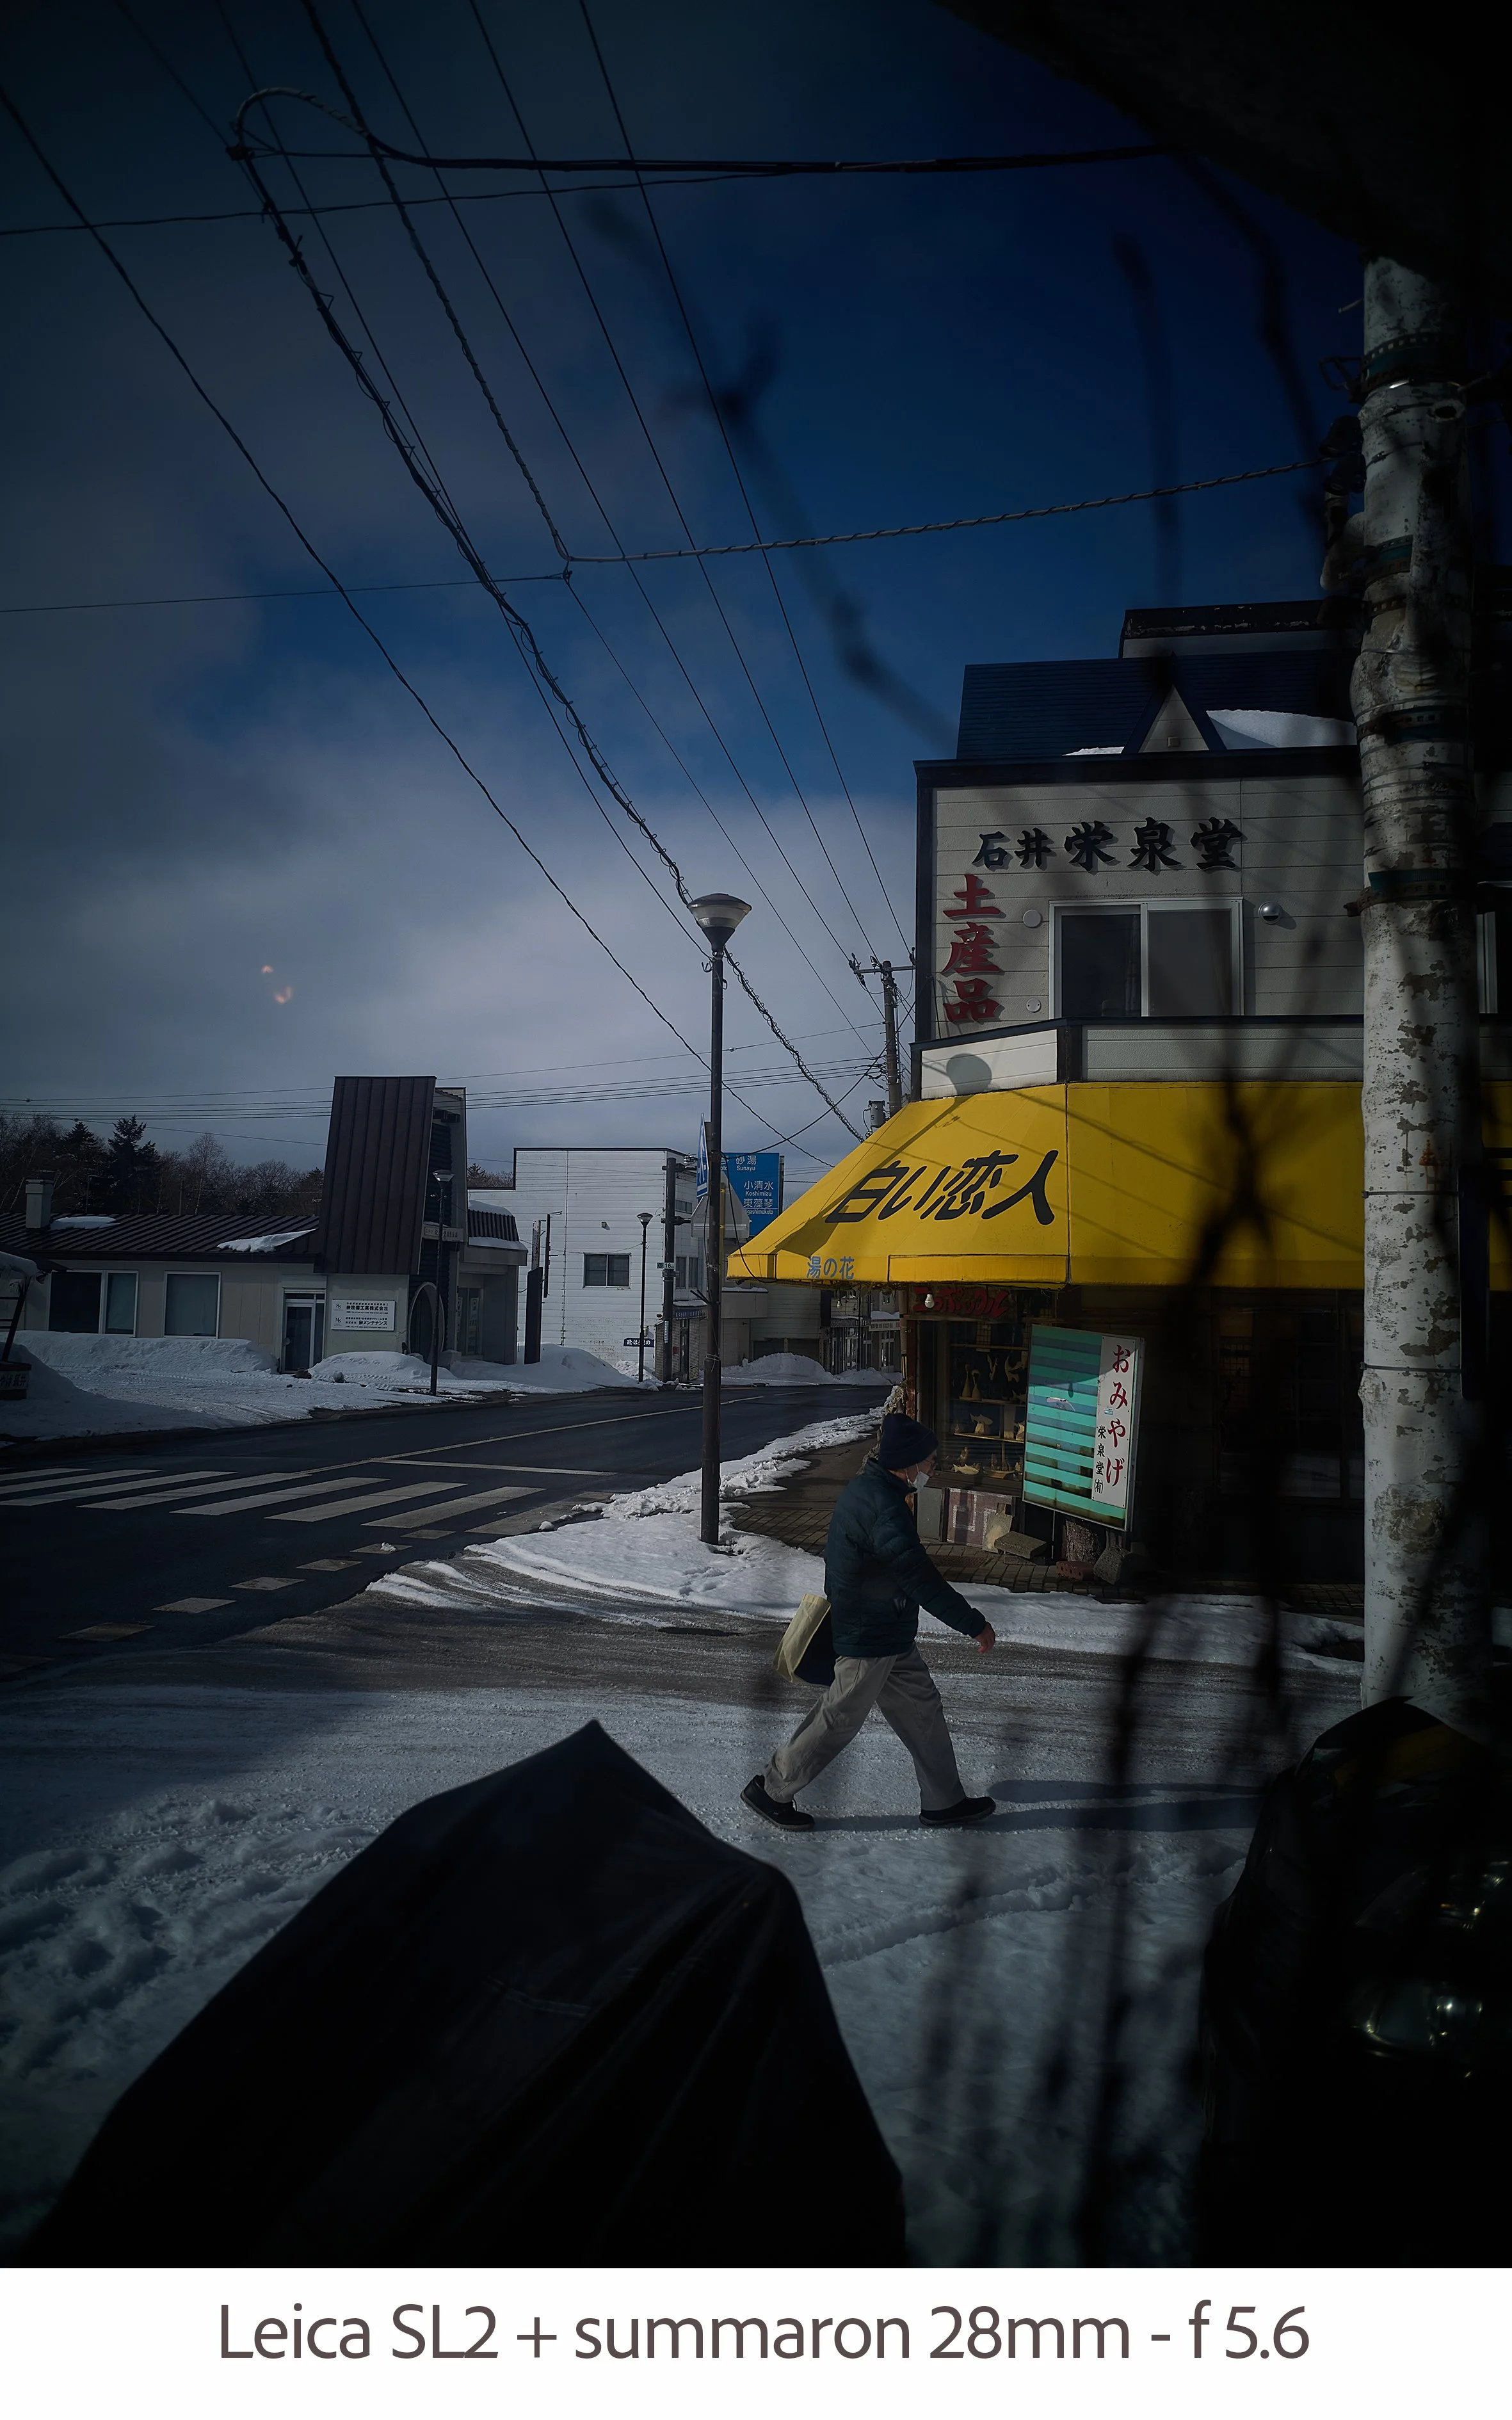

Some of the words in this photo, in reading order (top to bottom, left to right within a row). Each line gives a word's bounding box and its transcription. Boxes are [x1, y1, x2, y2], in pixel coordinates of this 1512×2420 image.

[971, 817, 1243, 871] 石井栄泉堂
[940, 874, 1005, 1023] 土産品
[736, 1155, 757, 1165] 砂湯
[743, 1198, 773, 1208] 東藻琴
[744, 1181, 774, 1190] 小清水
[824, 1150, 1059, 1225] 白い恋人
[807, 1256, 855, 1280] 湯の花
[1106, 1344, 1131, 1487] おみやげ
